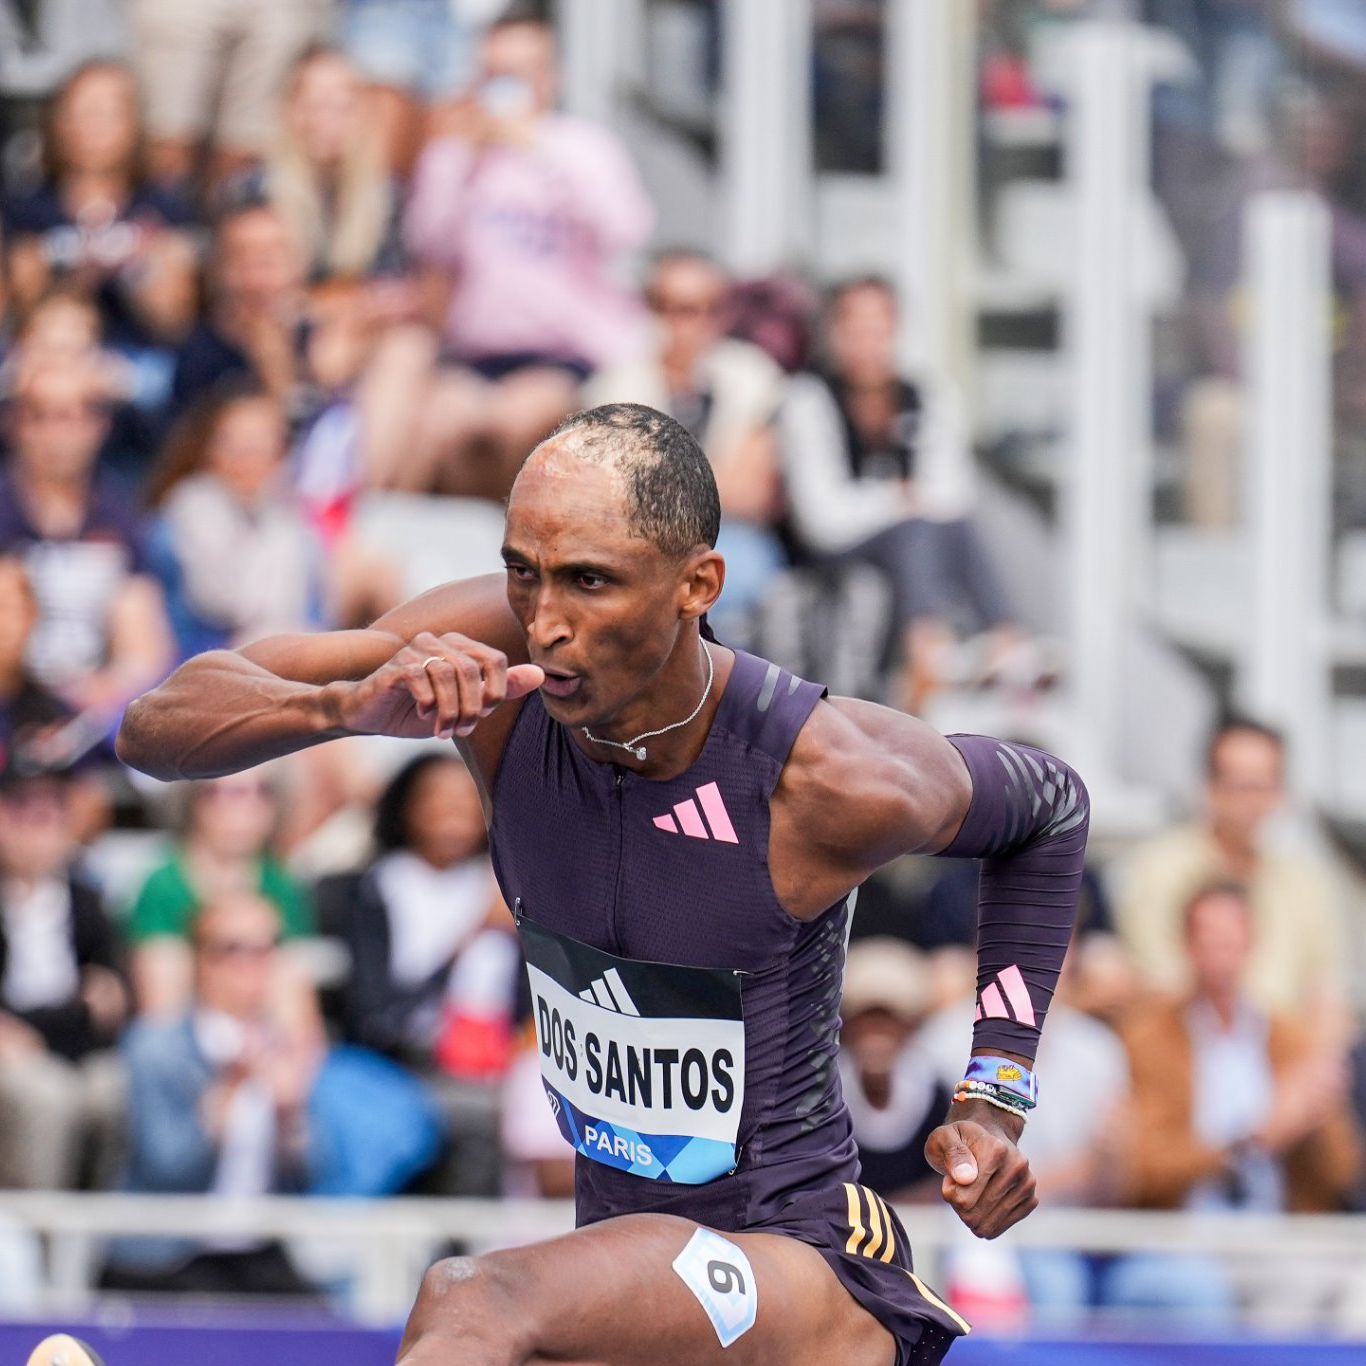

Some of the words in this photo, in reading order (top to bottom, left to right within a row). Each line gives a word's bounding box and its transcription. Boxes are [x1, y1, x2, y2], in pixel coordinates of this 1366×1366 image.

[537, 994, 577, 1082] DOS
[584, 1032, 735, 1114] SANTOS
[584, 1124, 653, 1166] PARIS
